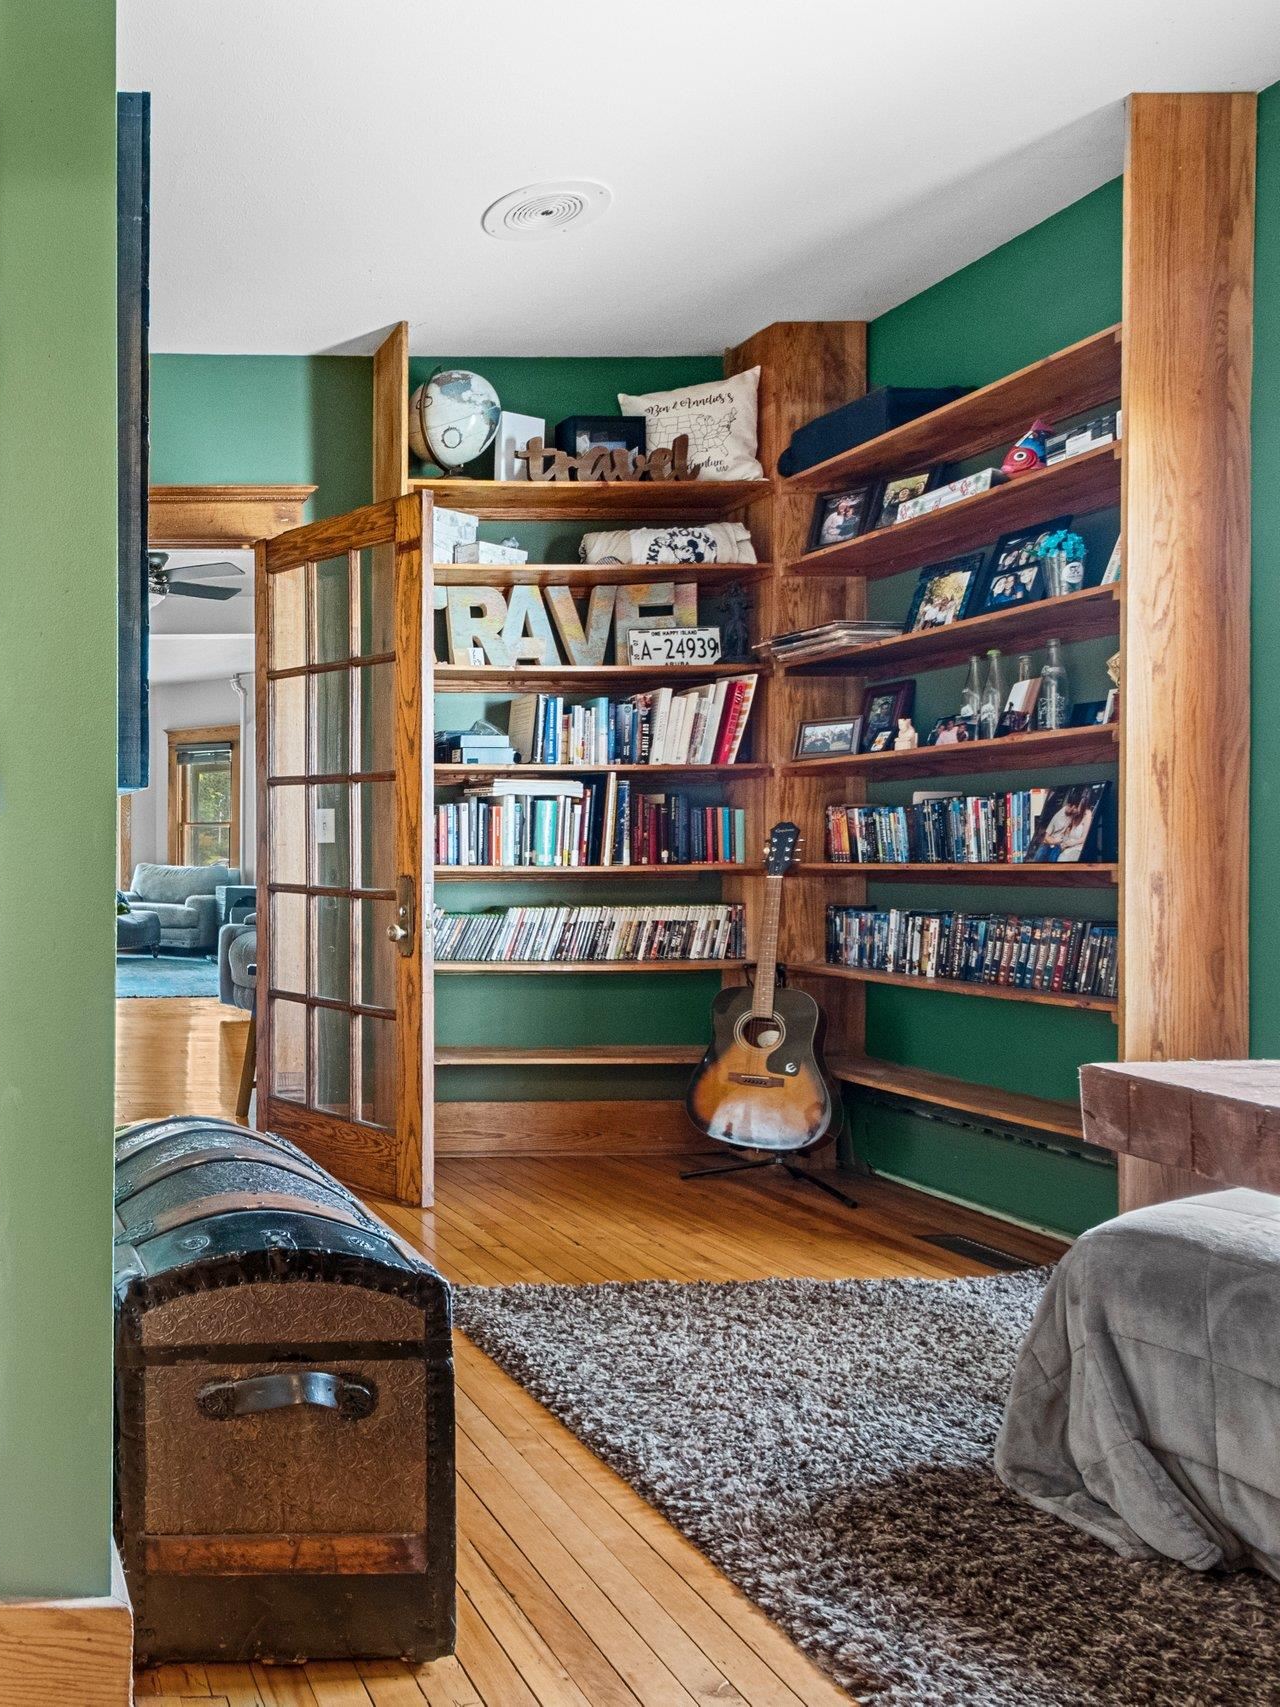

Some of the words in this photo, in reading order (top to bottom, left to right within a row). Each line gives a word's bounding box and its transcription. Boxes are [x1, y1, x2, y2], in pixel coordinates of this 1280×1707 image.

[645, 404, 669, 416] Ben
[514, 434, 701, 481] travel
[686, 456, 724, 470] dventure
[646, 537, 662, 564] KEY
[668, 529, 717, 550] MOUSE
[640, 637, 717, 660] A-24939
